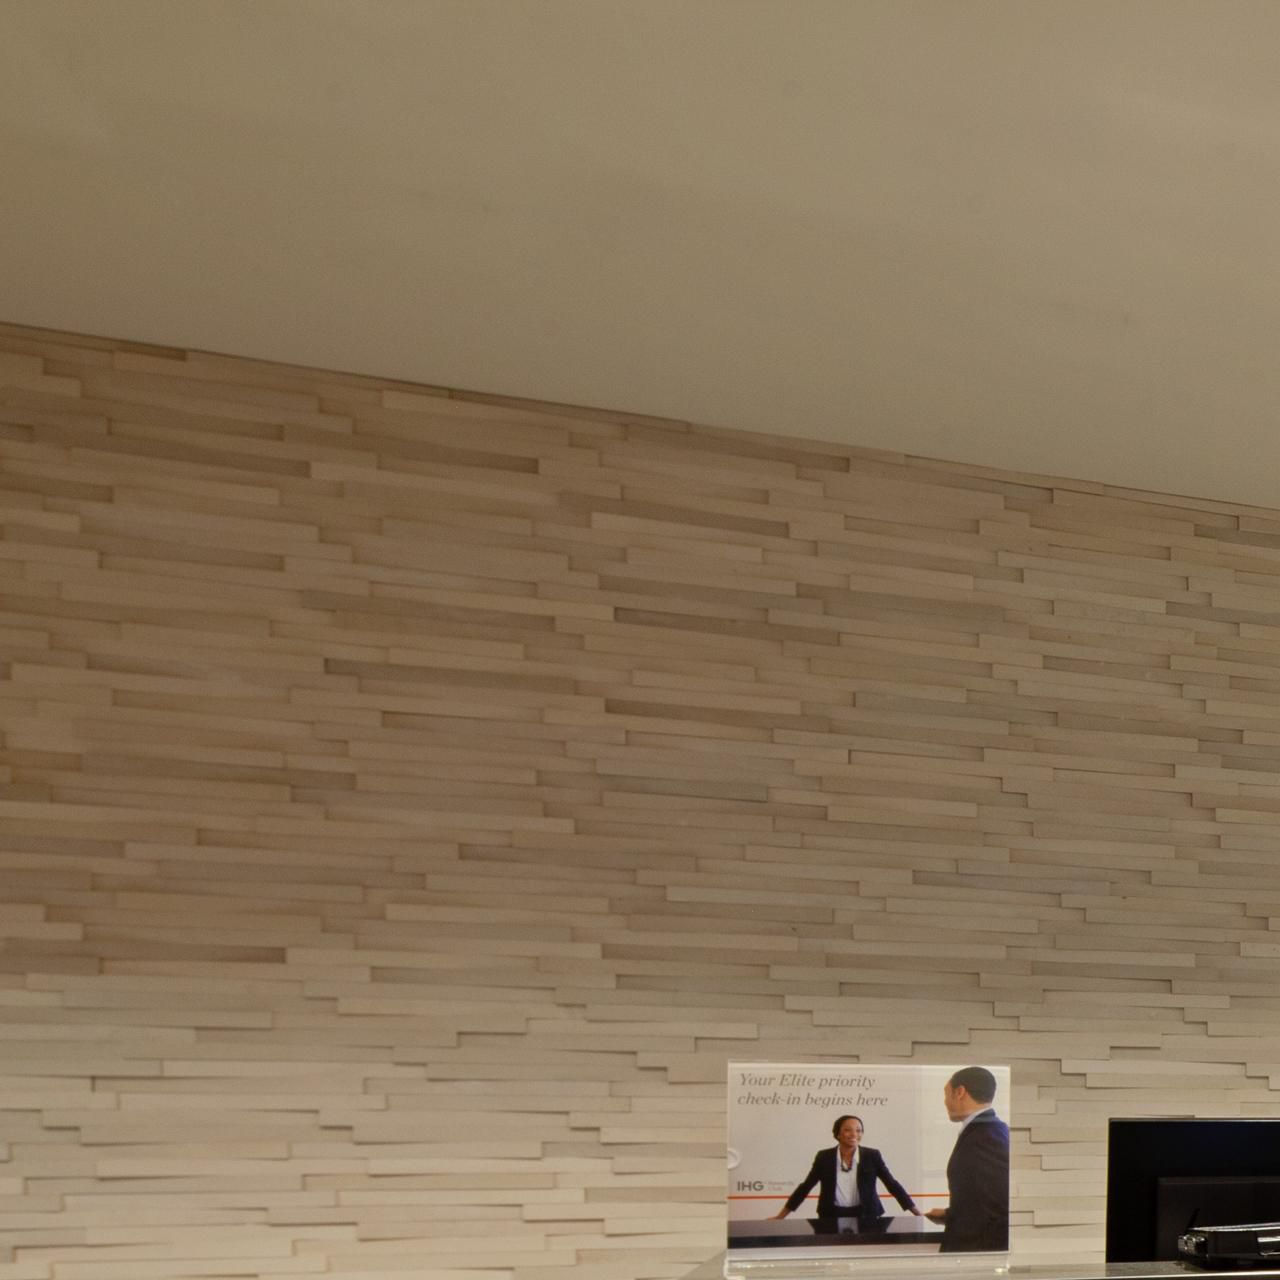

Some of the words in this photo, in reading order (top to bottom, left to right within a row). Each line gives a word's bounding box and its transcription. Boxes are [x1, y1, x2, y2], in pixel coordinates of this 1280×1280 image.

[739, 1073, 776, 1087] Your
[779, 1073, 815, 1087] Elite
[818, 1074, 876, 1090] priority
[737, 1091, 801, 1105] check-in
[805, 1092, 853, 1108] begins
[856, 1092, 888, 1106] here
[737, 1180, 764, 1192] IHG
